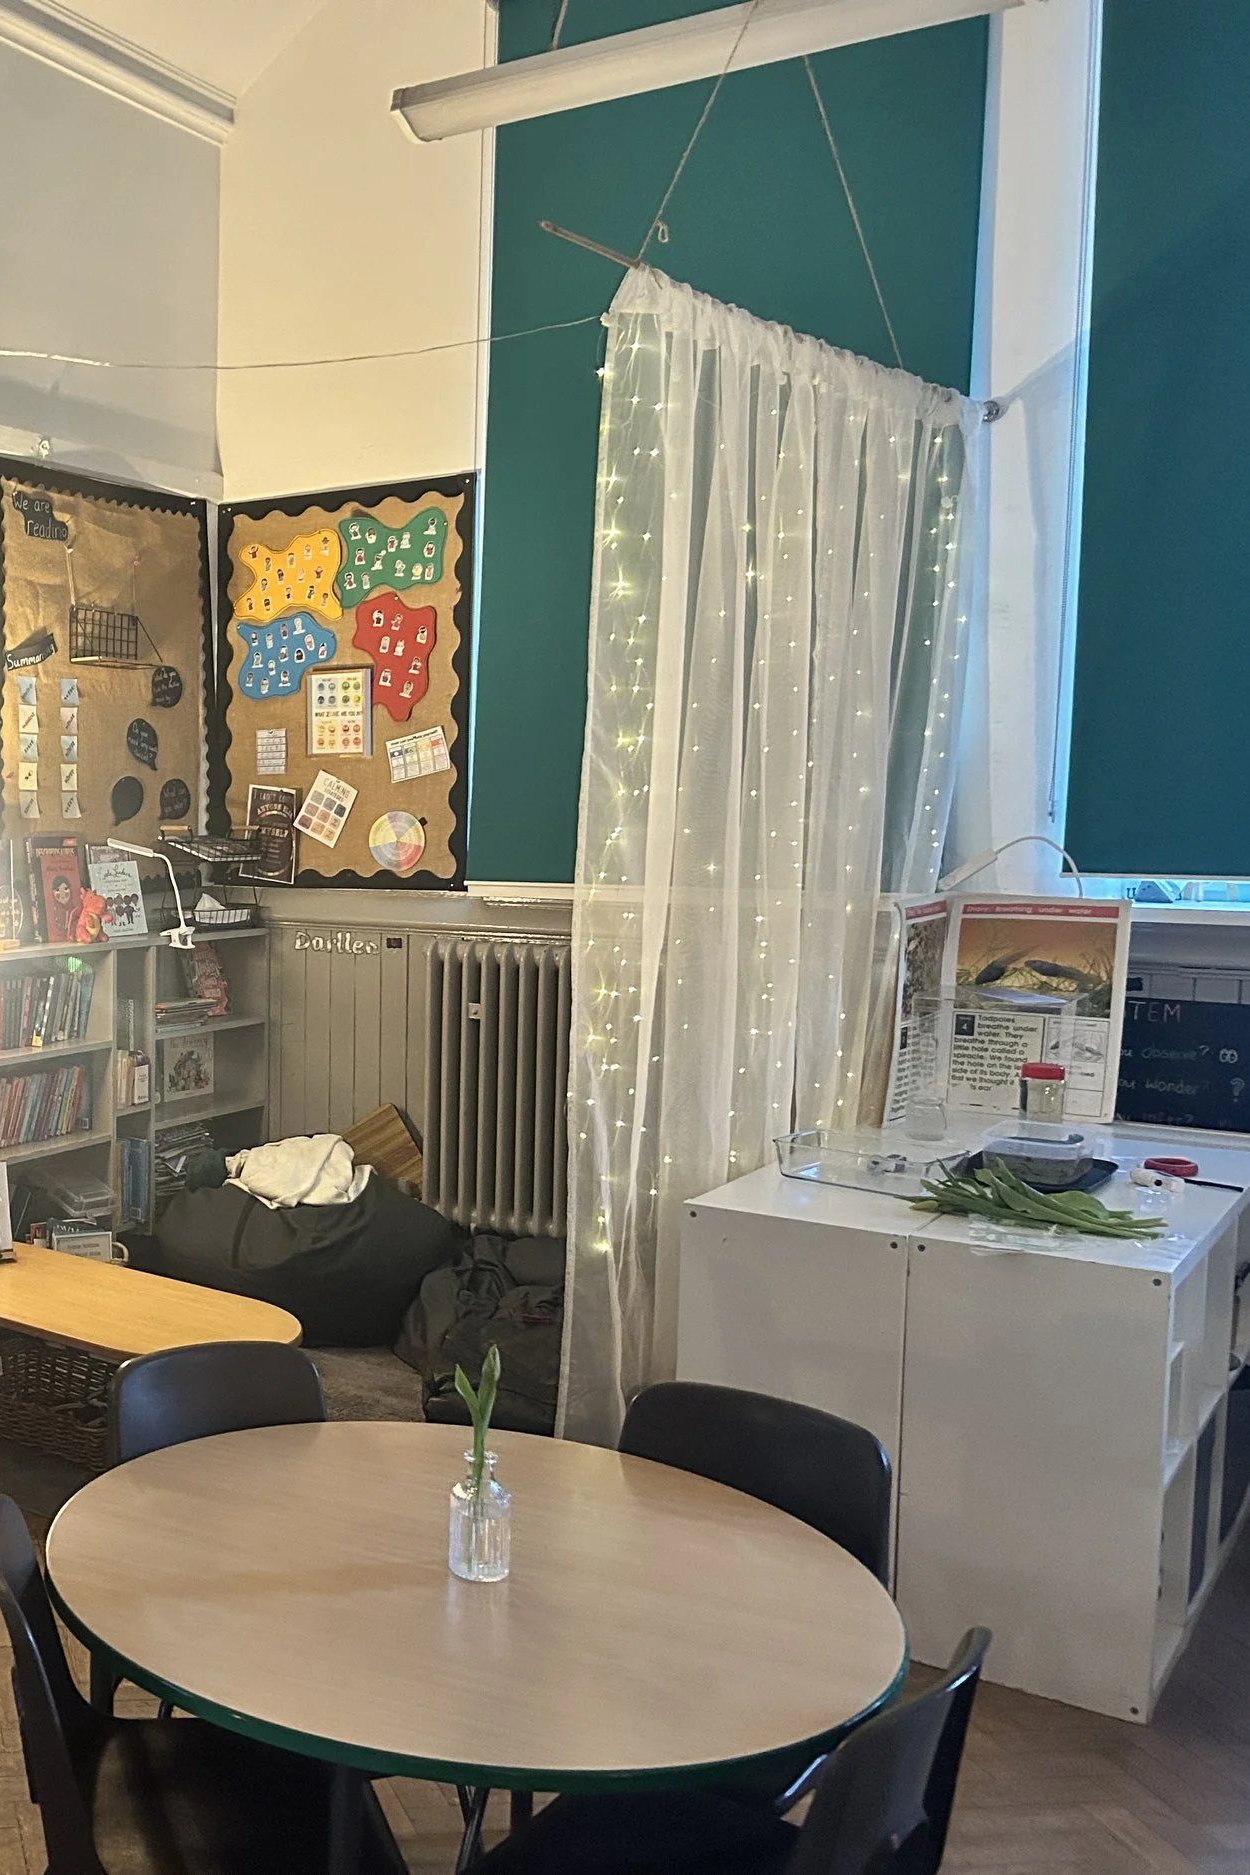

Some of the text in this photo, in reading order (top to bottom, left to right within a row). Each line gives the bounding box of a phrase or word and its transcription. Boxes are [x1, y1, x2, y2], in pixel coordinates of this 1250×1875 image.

[14, 493, 50, 513] We are
[1038, 906, 1063, 914] under
[1124, 1001, 1181, 1023] TEM
[977, 1015, 1016, 1024] Tadpoles
[977, 1023, 1010, 1031] breathe
[1005, 1032, 1024, 1040] They
[988, 1038, 1019, 1047] through
[971, 1045, 989, 1053] hole
[991, 1047, 1016, 1055] called
[1004, 1055, 1028, 1063] found
[967, 1060, 985, 1068] hole
[999, 1062, 1012, 1070] the
[970, 1067, 978, 1075] of
[979, 1075, 1008, 1086] thought
